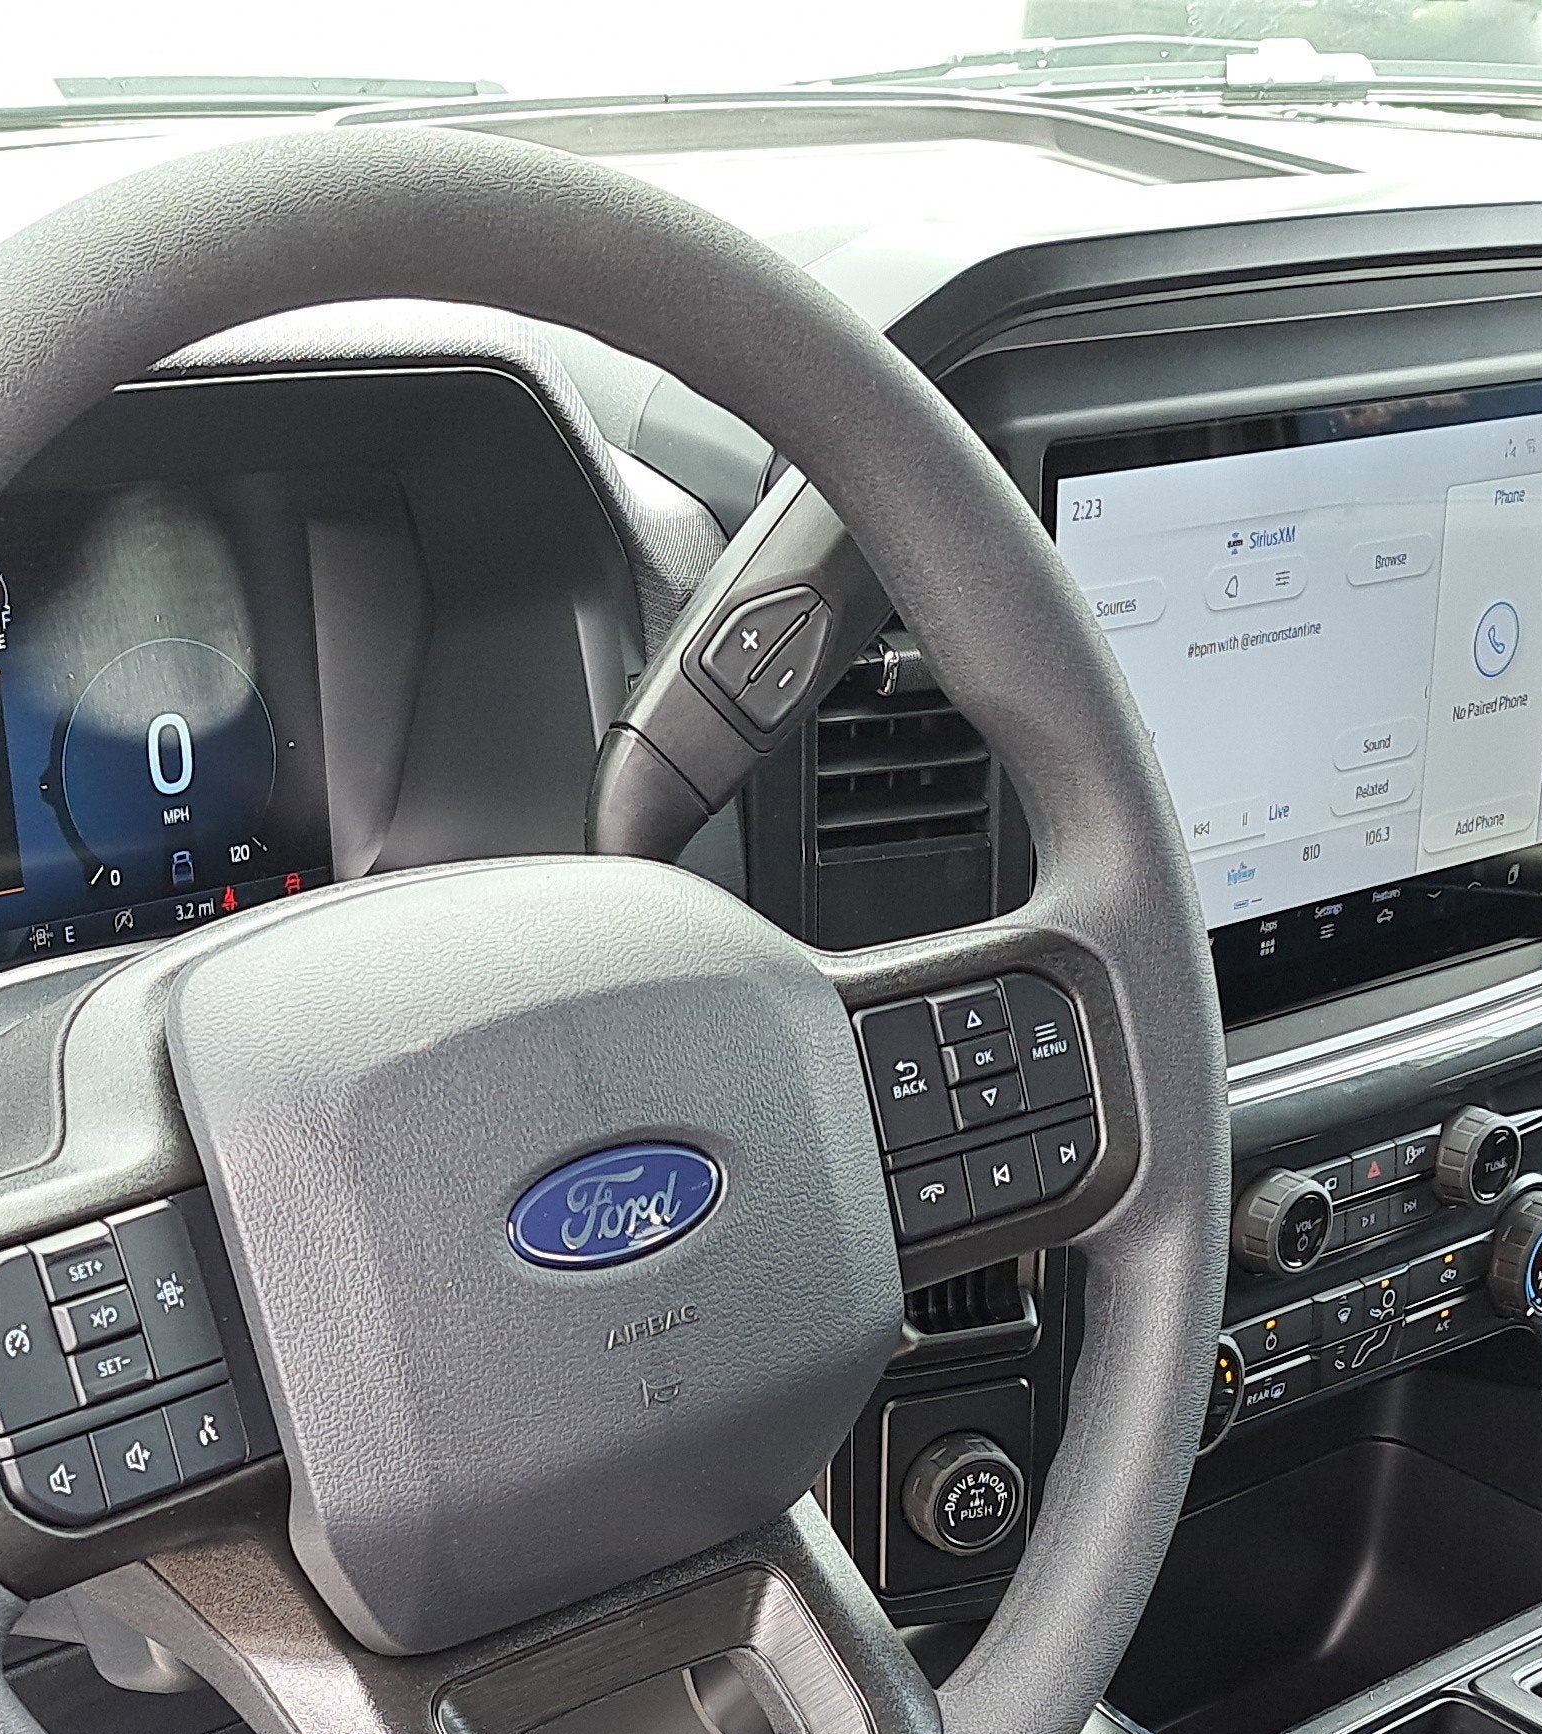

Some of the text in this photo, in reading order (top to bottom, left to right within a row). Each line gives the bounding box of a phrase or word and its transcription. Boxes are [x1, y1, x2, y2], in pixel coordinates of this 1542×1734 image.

[1494, 489, 1526, 506] Phone
[1072, 498, 1102, 522] 2:23
[1248, 525, 1296, 550] SiriusXM
[1375, 553, 1407, 570] Browse
[1095, 598, 1137, 618] Sources
[1, 610, 11, 630] F
[1218, 635, 1239, 653] with
[1452, 692, 1528, 722] No Paired Phone
[147, 712, 195, 795] 0
[1362, 734, 1391, 754] Sound
[1355, 779, 1389, 800] Related
[163, 805, 190, 825] MPH
[1269, 803, 1290, 821] Live
[1455, 812, 1505, 836] Add Phone
[229, 844, 250, 863] 120
[110, 869, 121, 886] 0
[175, 903, 195, 921] 3.2
[64, 925, 76, 943] E
[974, 1049, 994, 1067] OK
[1031, 1039, 1068, 1062] MENU
[892, 1077, 928, 1100] BACK
[560, 1164, 682, 1251] Ford
[1295, 1219, 1312, 1234] VOL
[68, 1259, 105, 1283] SET+
[605, 1304, 701, 1352] AIRBAG
[1246, 1388, 1270, 1407] REAR
[943, 1471, 1008, 1512] DRIVE MODE
[960, 1504, 993, 1521] PUSH
